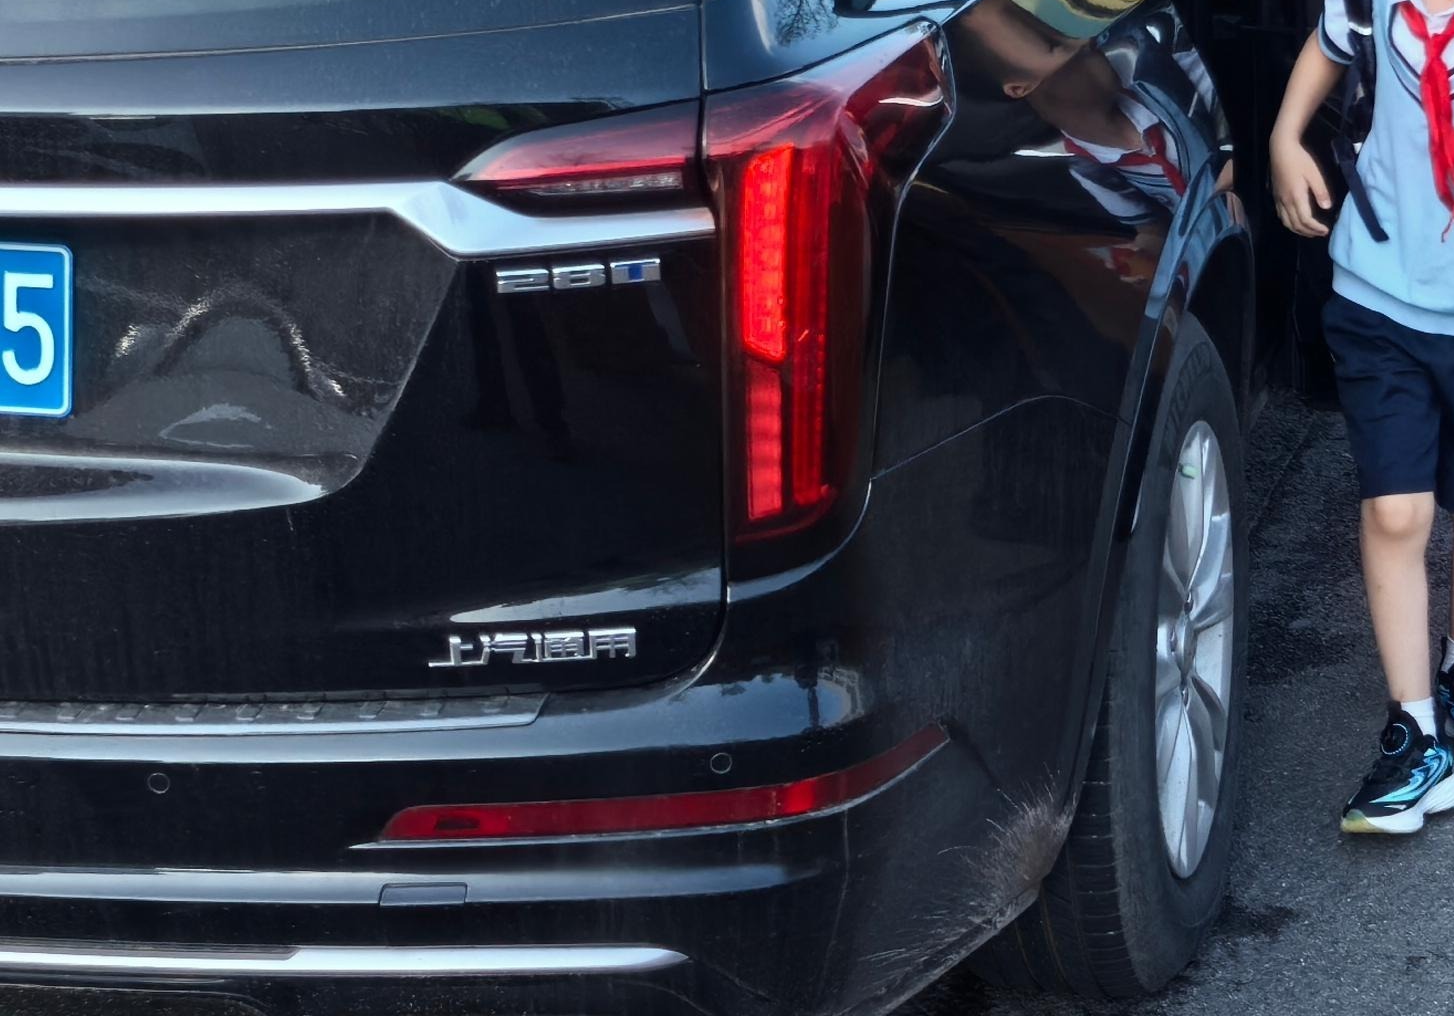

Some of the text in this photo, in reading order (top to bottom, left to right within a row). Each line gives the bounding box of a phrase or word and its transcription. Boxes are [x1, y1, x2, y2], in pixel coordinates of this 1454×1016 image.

[496, 258, 661, 294] 28T
[3, 270, 55, 386] 5
[428, 627, 637, 667] 上汽通用
